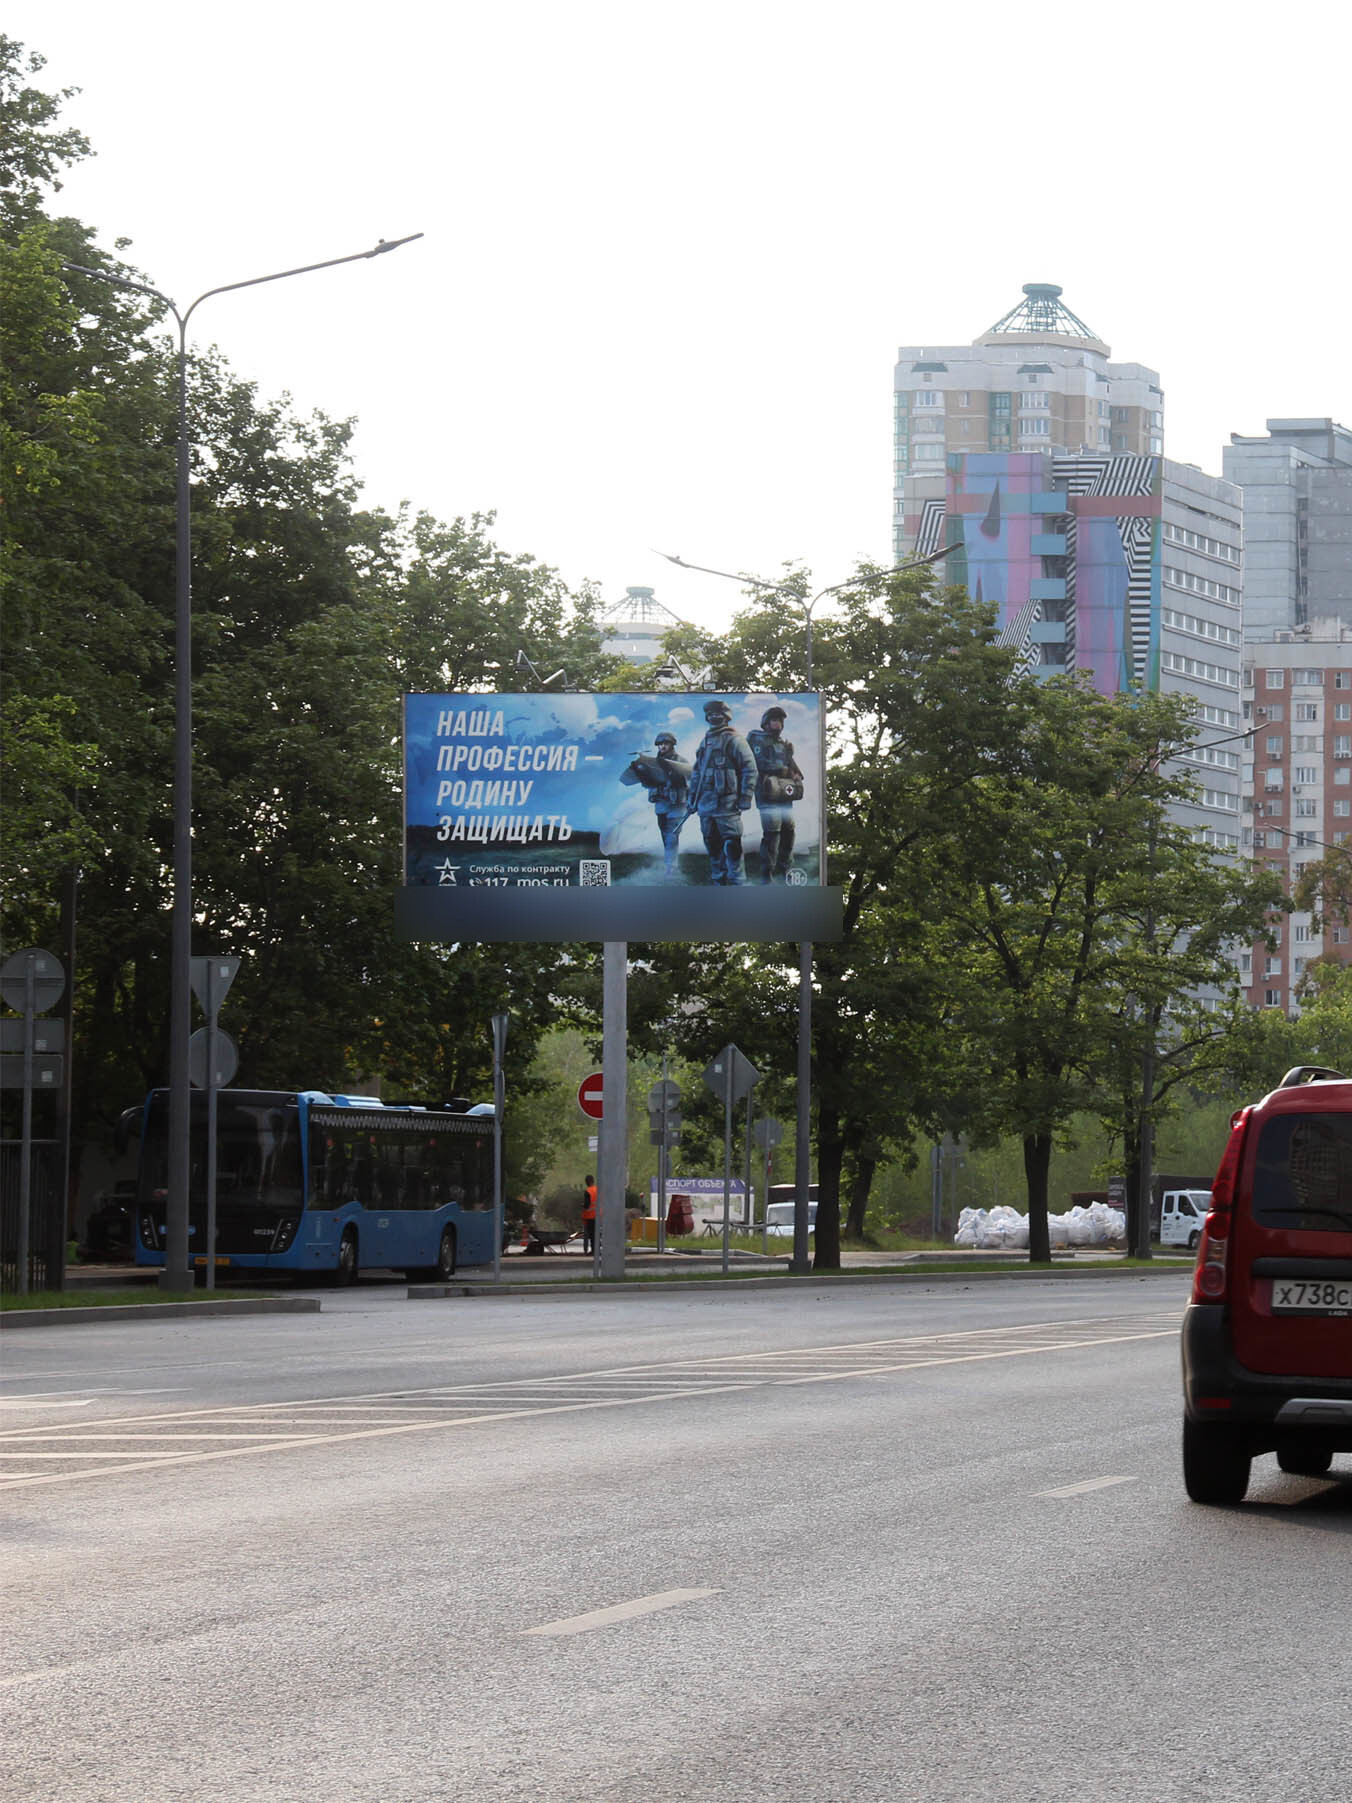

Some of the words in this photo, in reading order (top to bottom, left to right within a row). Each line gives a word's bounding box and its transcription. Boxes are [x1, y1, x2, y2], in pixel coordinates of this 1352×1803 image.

[436, 710, 504, 737] НАША
[436, 745, 579, 772] ПРОФЕССИЯ
[436, 780, 534, 809] РОДИНУ
[436, 815, 573, 844] ЗАЩИЩАТЬ
[469, 864, 505, 875] Служба
[521, 865, 571, 875] контракту
